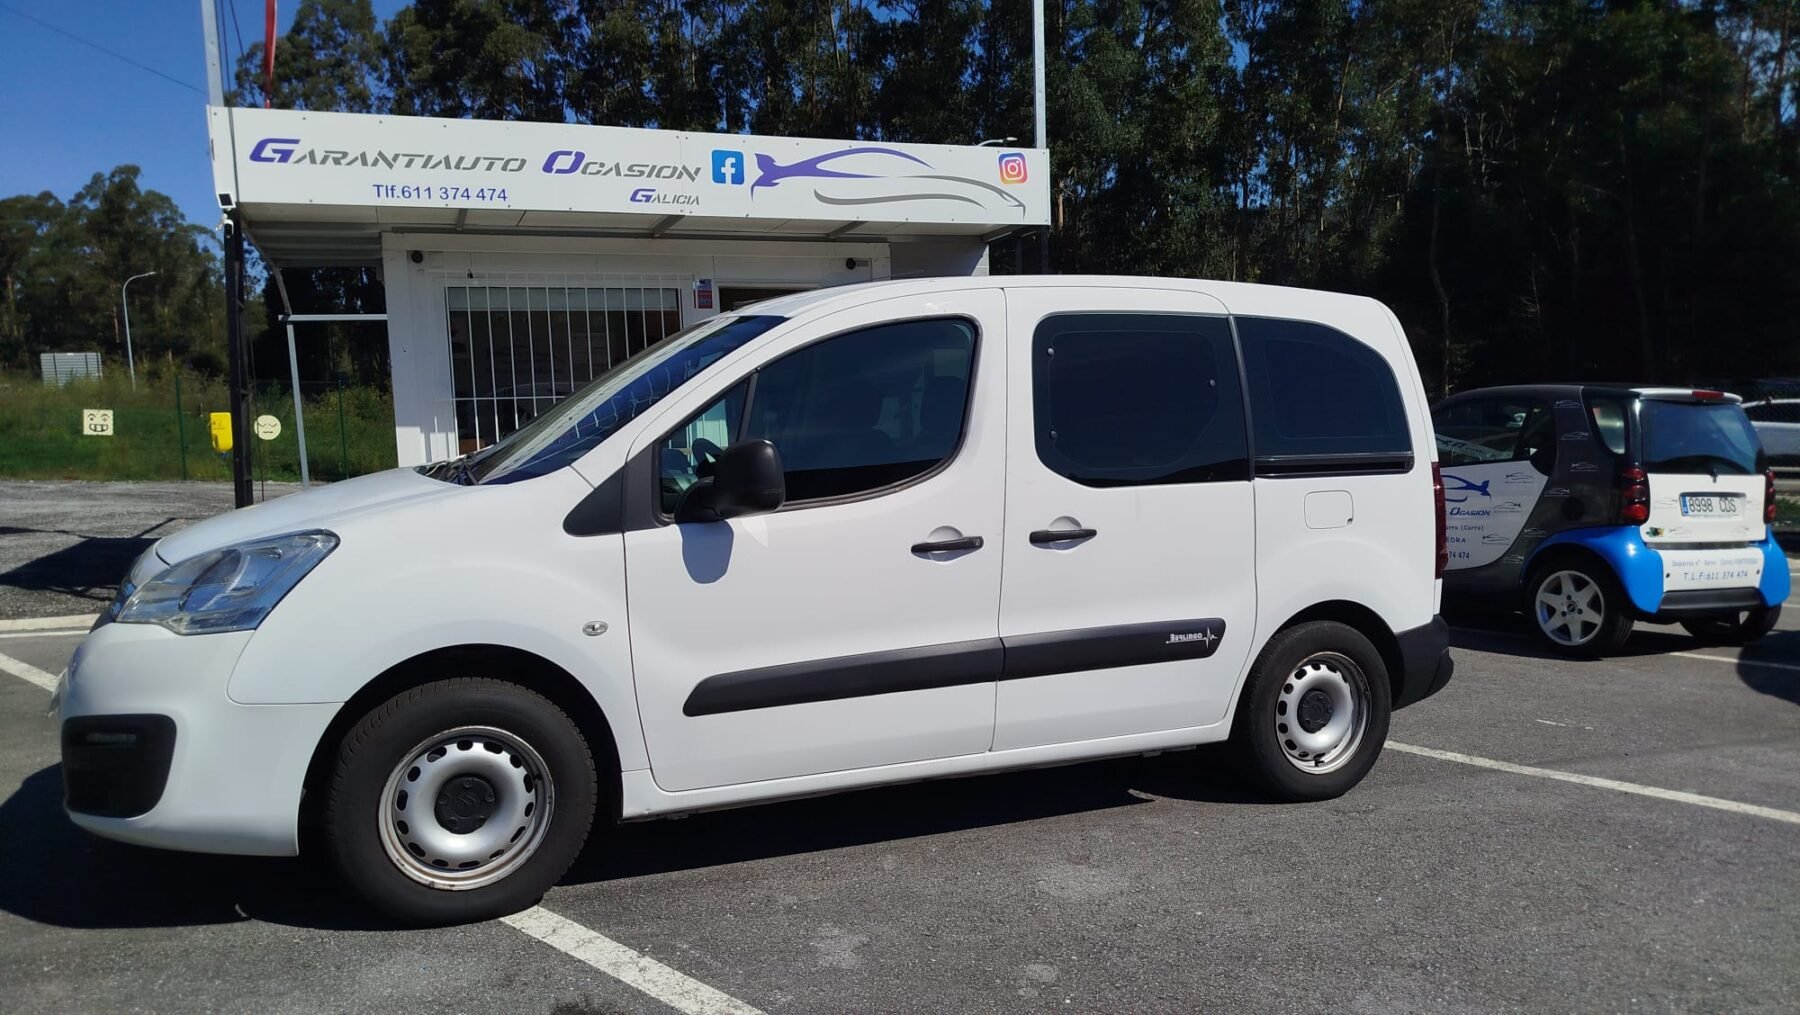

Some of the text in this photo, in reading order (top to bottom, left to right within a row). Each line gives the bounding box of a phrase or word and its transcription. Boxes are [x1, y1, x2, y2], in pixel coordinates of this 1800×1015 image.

[249, 137, 702, 183] GARANTIAUTO OCASION
[372, 184, 508, 202] Tlf.611 374 474
[629, 188, 701, 206] GALICIA
[1688, 498, 1736, 512] 8998 CDS
